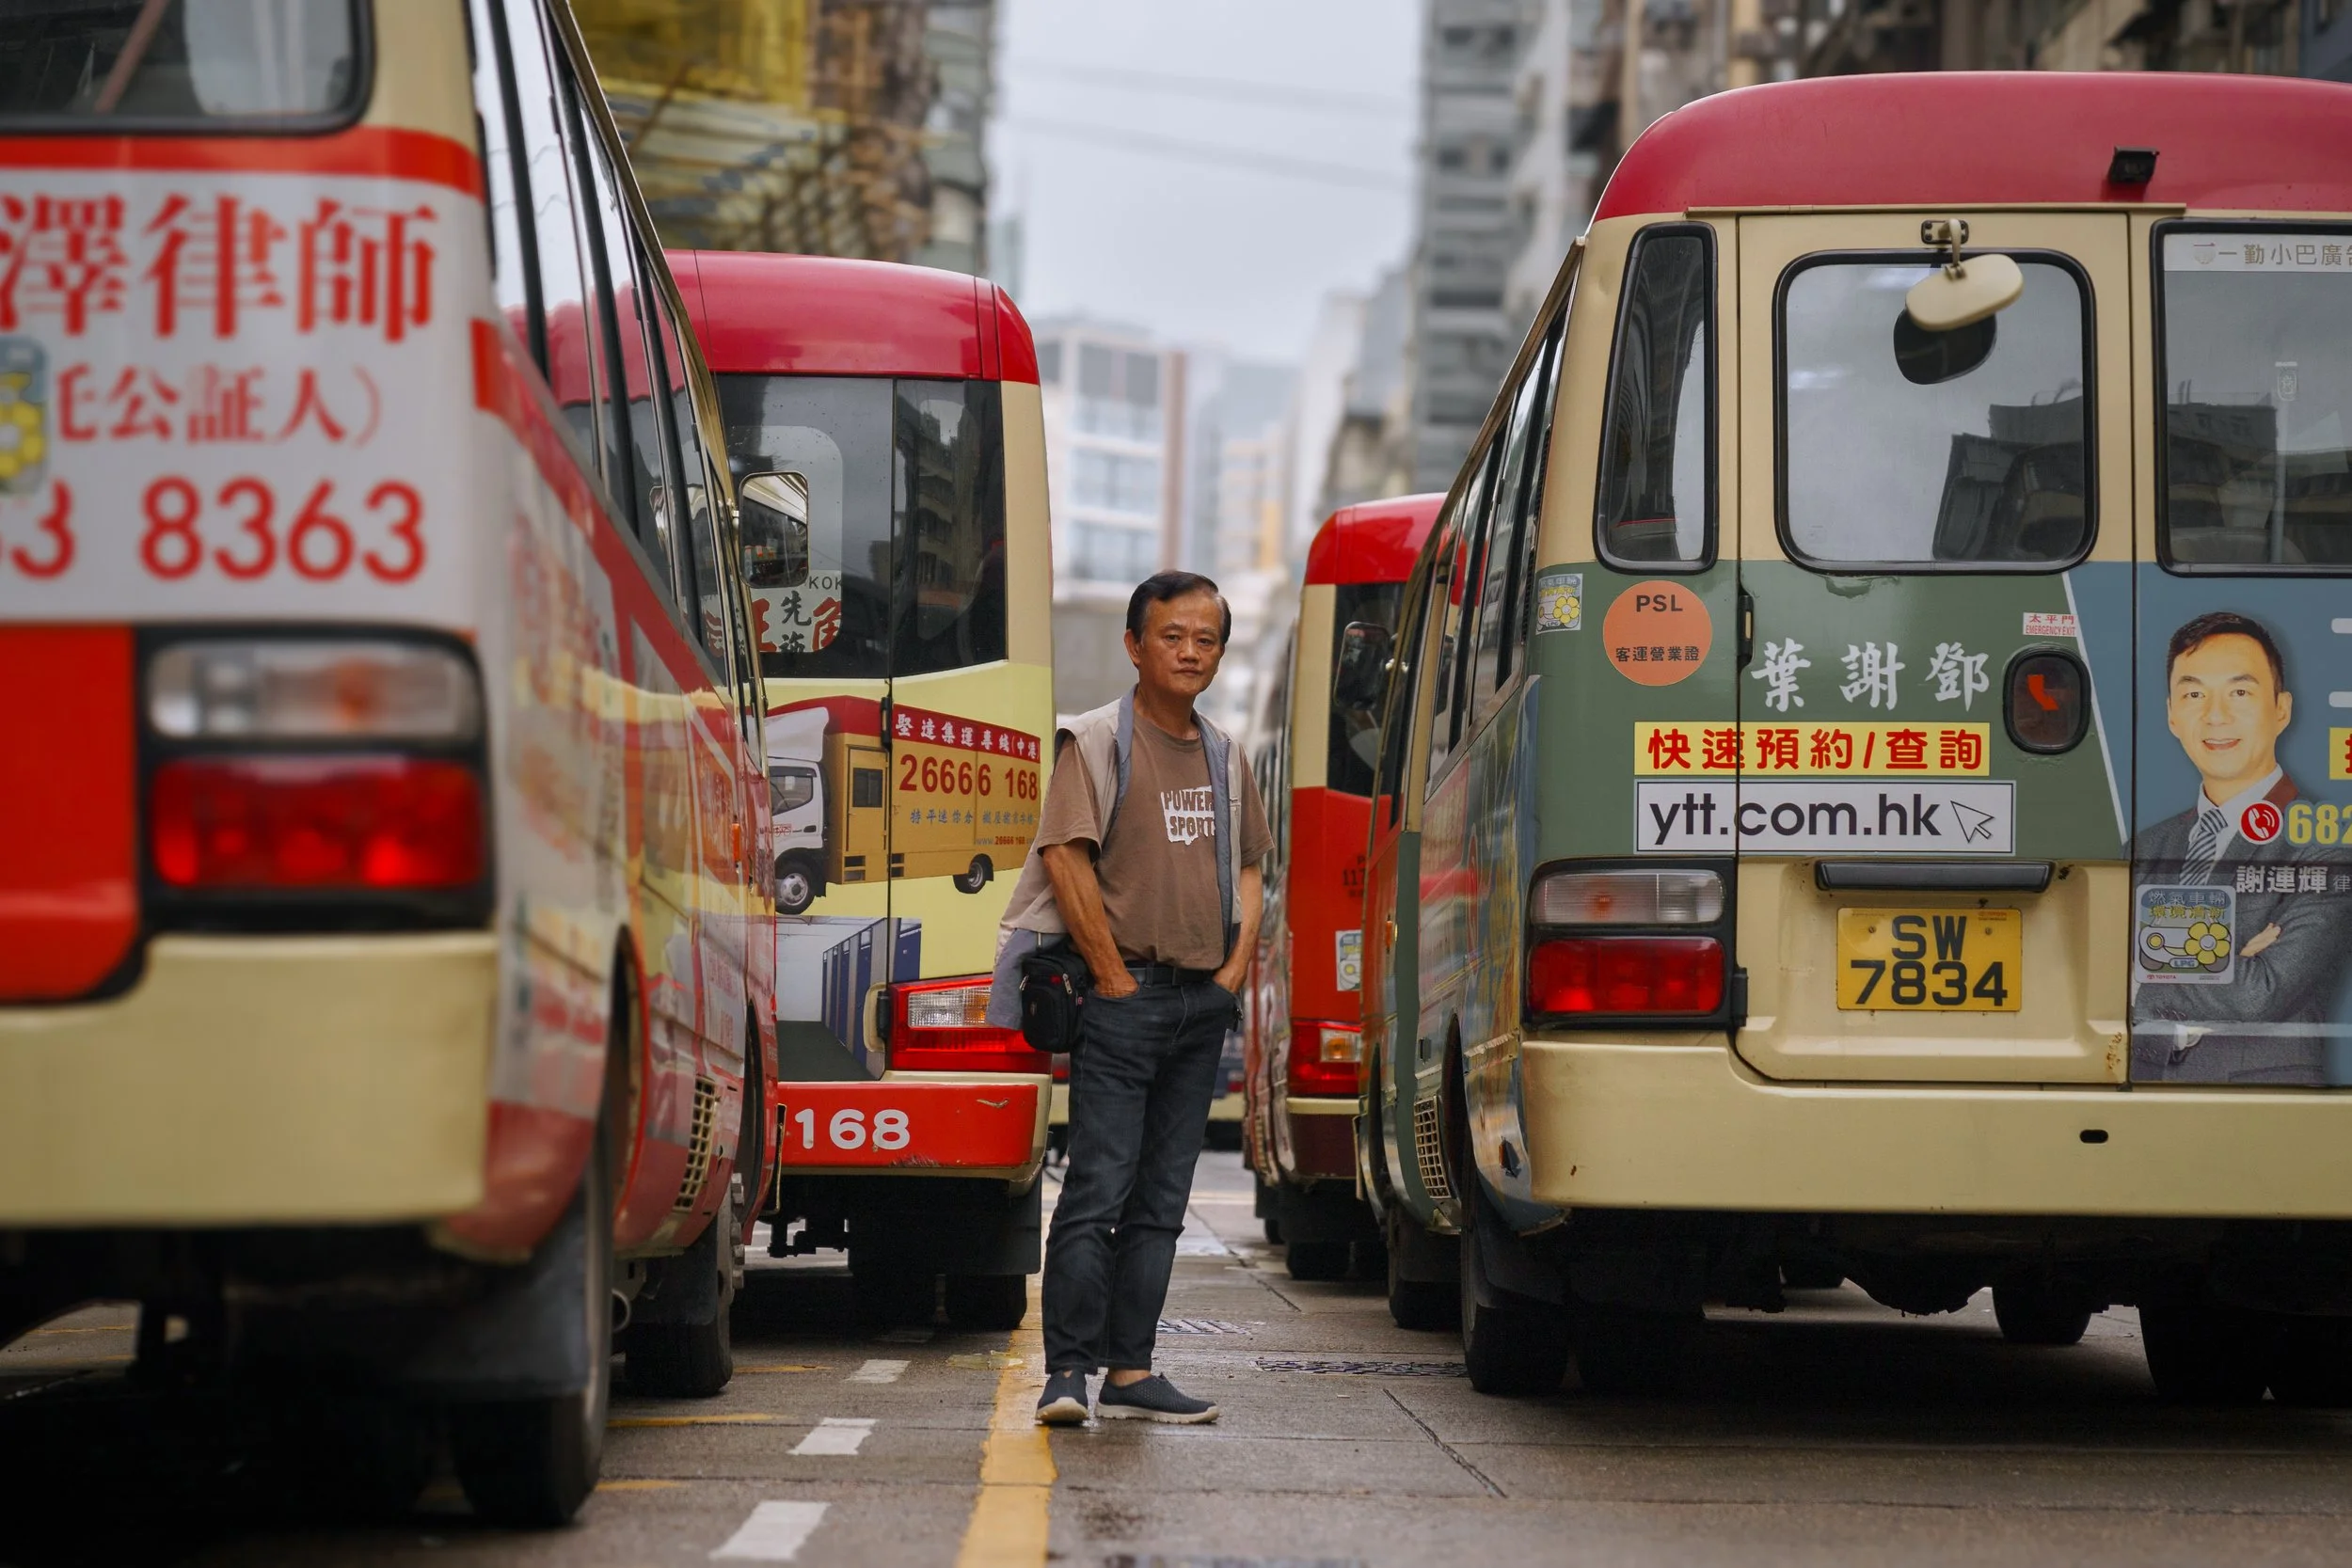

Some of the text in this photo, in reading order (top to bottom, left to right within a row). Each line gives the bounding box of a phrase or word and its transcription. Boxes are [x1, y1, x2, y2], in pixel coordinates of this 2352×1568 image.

[0, 192, 436, 341] 澤律師
[0, 476, 425, 584] 3 8363
[1635, 594, 1684, 613] PSL
[2028, 614, 2074, 625] 太平門
[2026, 625, 2076, 636] EMERGENCY EXIT
[1614, 644, 1701, 663] 客運營業證
[1750, 637, 1991, 713] 葉謝鄧
[1647, 727, 1983, 771] 快速預約/查詢
[898, 753, 1038, 801] 26666 168
[1648, 792, 1943, 847] ytt.com.hk
[2235, 865, 2328, 894] 謝連輝
[1891, 914, 1967, 961] SW
[1850, 959, 2009, 1006] 7834
[794, 1108, 911, 1150] 168
